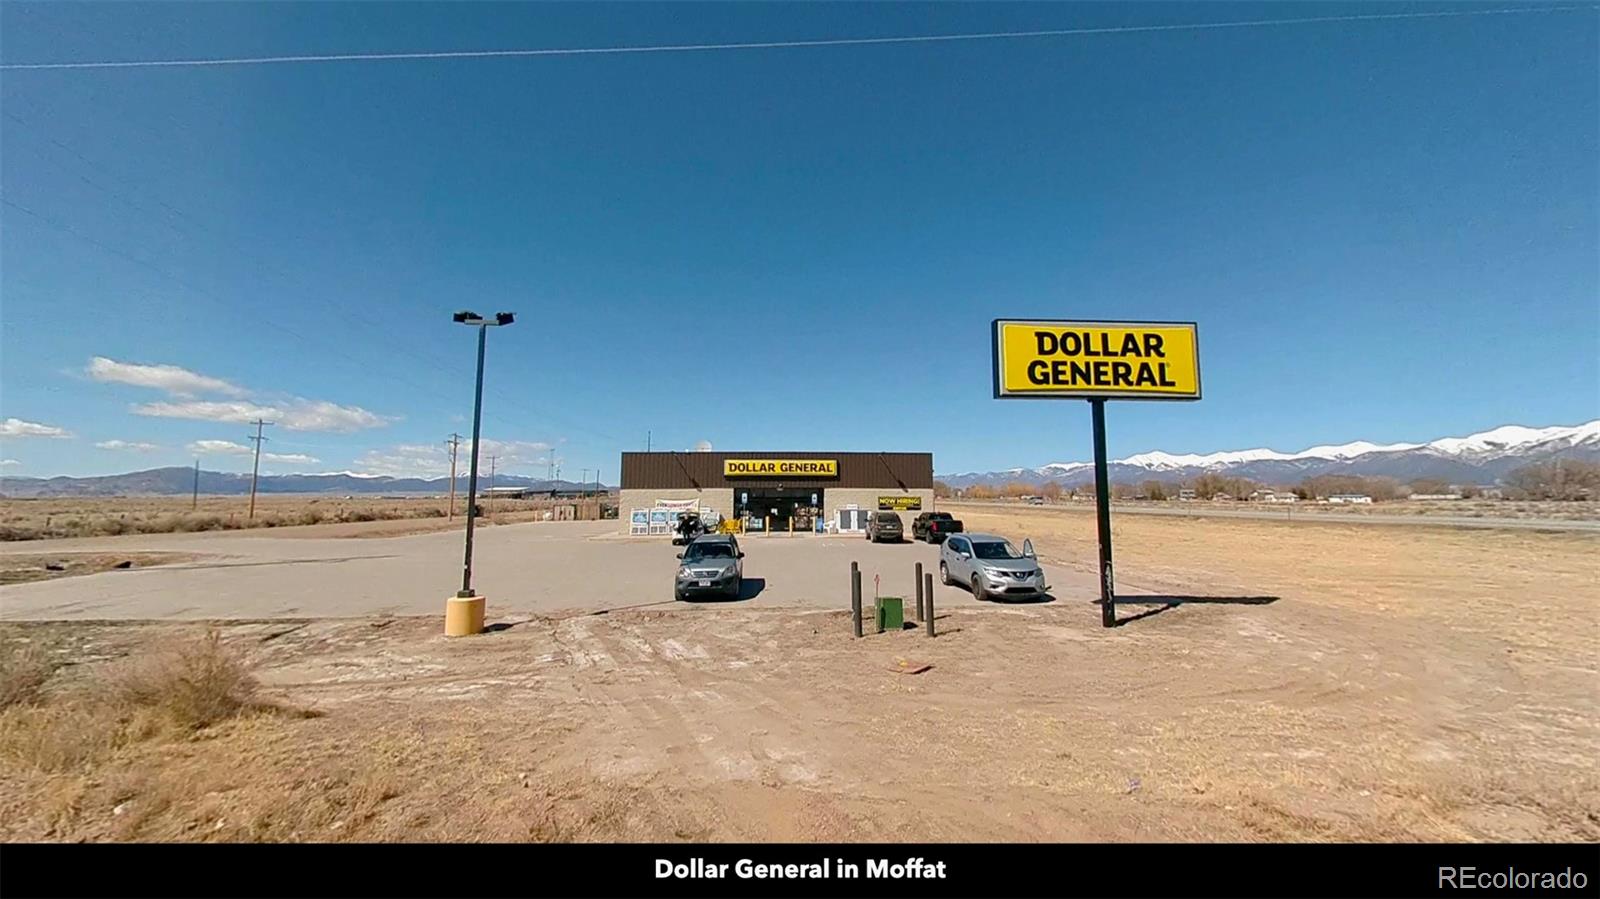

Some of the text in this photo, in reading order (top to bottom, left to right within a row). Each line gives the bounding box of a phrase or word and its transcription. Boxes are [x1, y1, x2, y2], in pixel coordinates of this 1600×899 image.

[1034, 331, 1166, 358] DOLLAR
[1027, 360, 1176, 387] GENERAL
[728, 462, 833, 473] DOLLAR GENERAL
